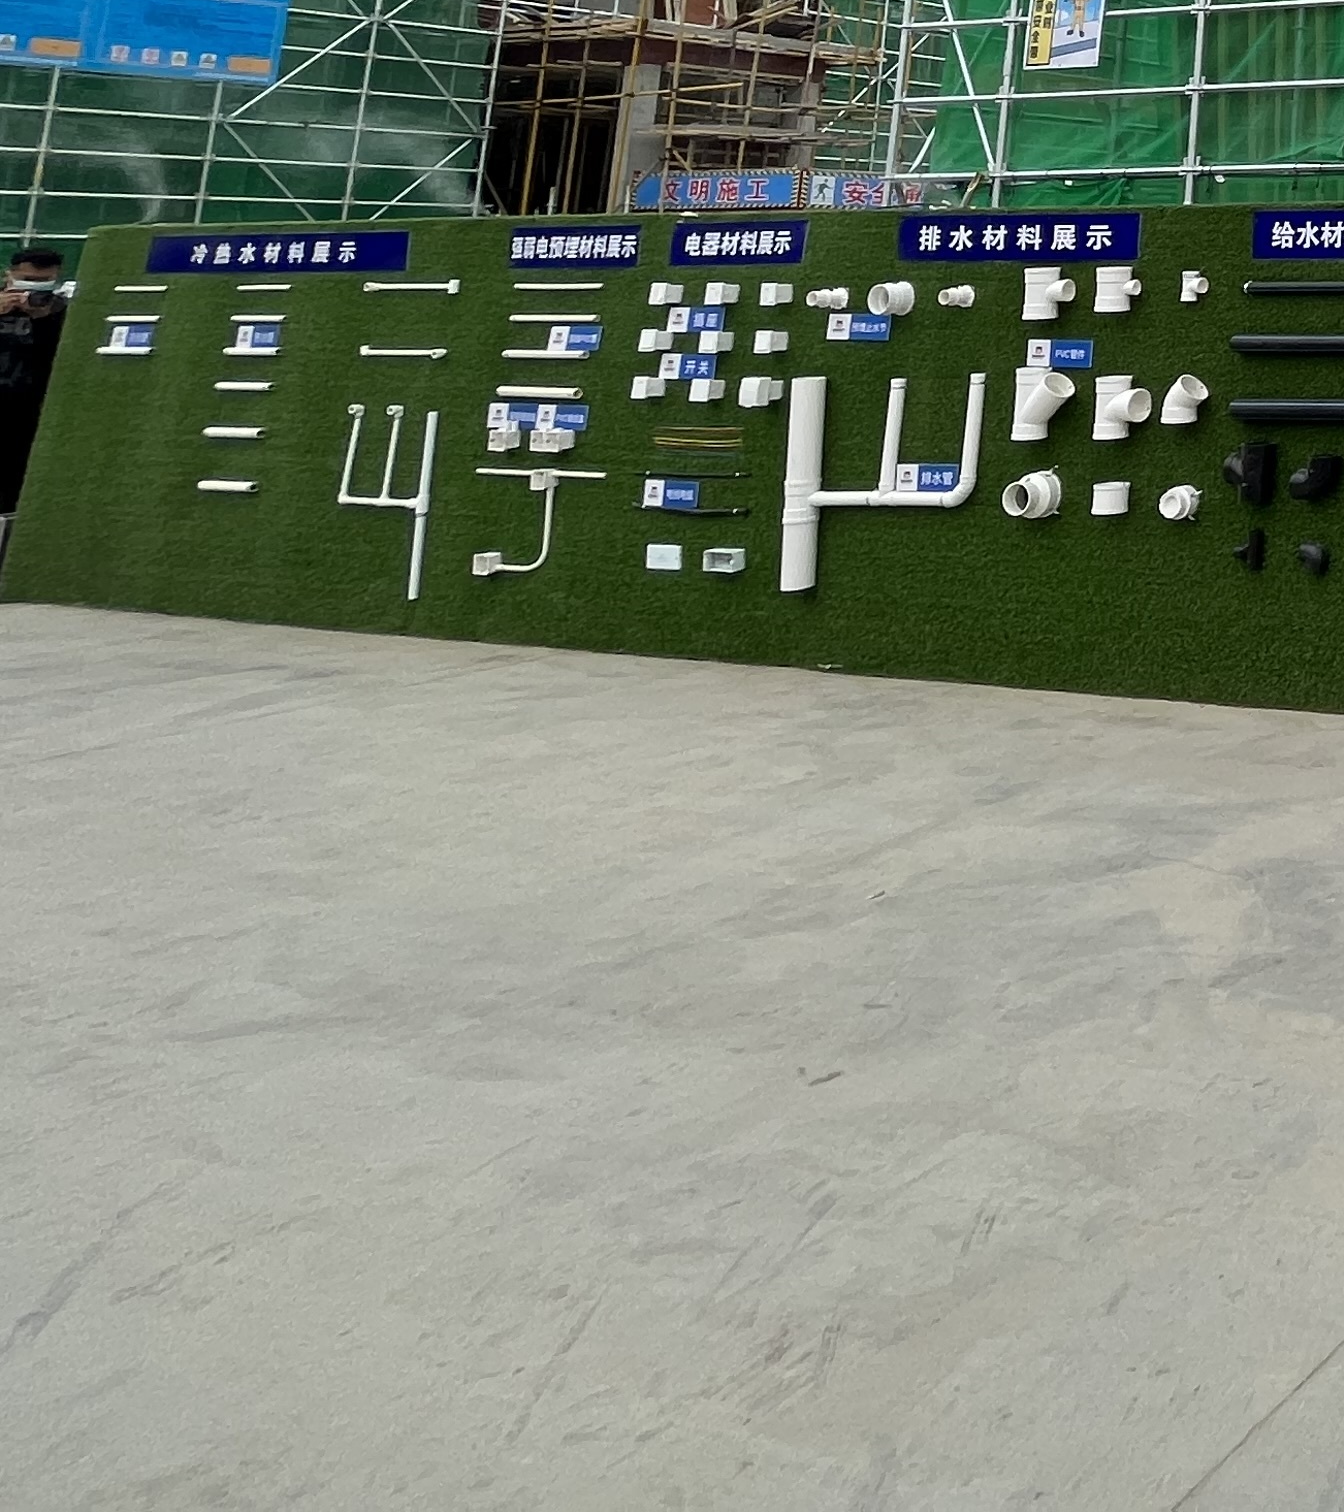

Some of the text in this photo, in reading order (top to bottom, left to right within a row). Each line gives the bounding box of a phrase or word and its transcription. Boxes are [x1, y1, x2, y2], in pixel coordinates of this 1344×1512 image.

[664, 178, 770, 204] 文明施工
[510, 234, 638, 260] 强弱电预埋材料展示
[684, 230, 793, 256] 电器材料展示
[918, 224, 1113, 251] 排水材料展示
[189, 240, 358, 265] 冷热水材料展示
[683, 359, 709, 375] 开关
[920, 471, 954, 486] 排水管
